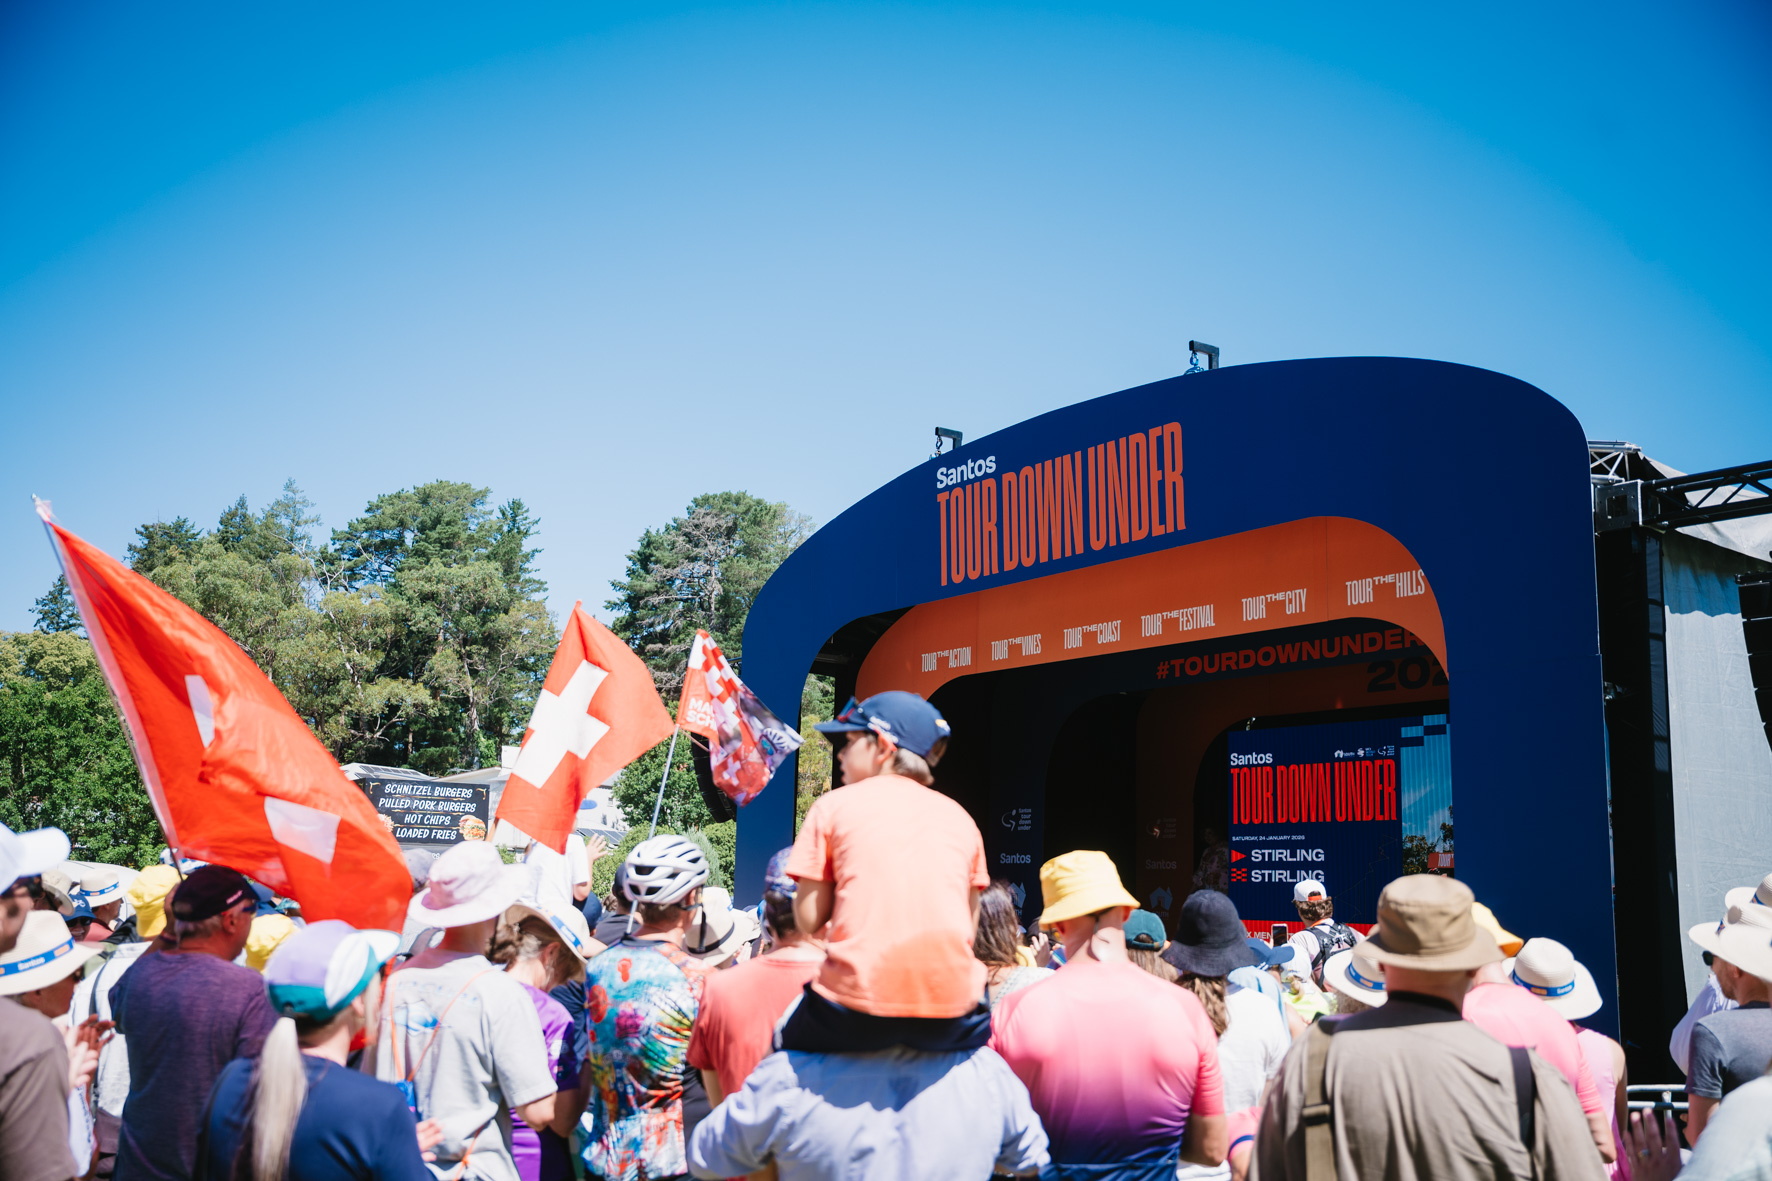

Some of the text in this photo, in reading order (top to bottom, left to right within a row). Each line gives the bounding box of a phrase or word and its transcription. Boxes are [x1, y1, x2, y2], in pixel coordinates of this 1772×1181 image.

[937, 455, 996, 489] Santos
[937, 422, 1186, 586] TOUR DOWN UNDER
[1345, 569, 1425, 606] TOUR THE HILLS
[1241, 588, 1307, 621] TOUR THE CITY
[1141, 604, 1215, 637] TOUR THE FESTIVAL
[1063, 620, 1121, 649] TOUR THE COAST
[991, 633, 1042, 661] TOUR THE VINES
[1156, 628, 1425, 680] #TOURDOWNUNDER
[921, 646, 971, 672] TOUR THE ACTION
[688, 697, 714, 714] MA
[1230, 752, 1273, 766] Santos
[384, 783, 473, 798] SCHNITZEL BURGERS
[1230, 759, 1397, 824] TOUR DOWN UNDER
[378, 797, 477, 813] PULLED PORK BURGERS
[404, 813, 451, 825] HOT CHIPS
[396, 827, 457, 840] LOADED FRIES
[1000, 852, 1031, 864] Santos
[1145, 859, 1177, 870] Santos
[1251, 848, 1325, 862] STIRLING
[1251, 869, 1325, 883] STIRLING
